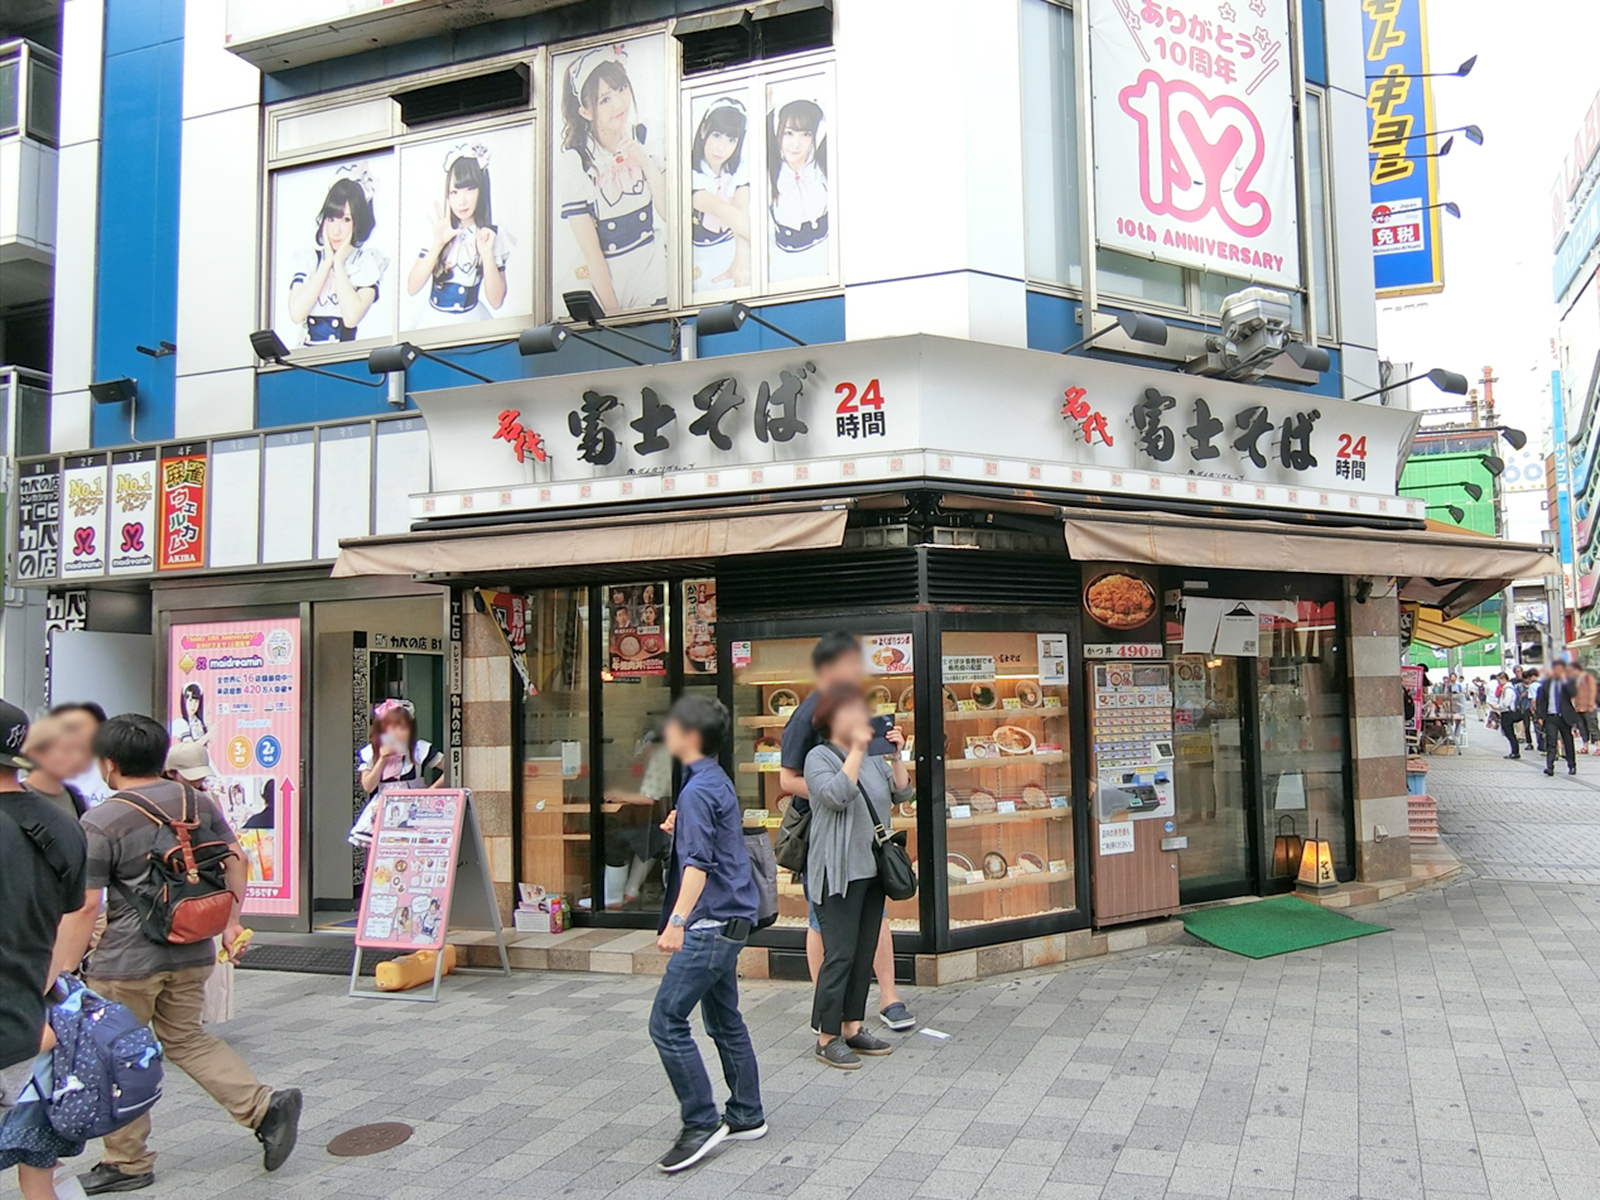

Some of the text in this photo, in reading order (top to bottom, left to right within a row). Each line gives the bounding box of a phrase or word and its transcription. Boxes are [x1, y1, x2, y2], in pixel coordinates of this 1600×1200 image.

[1140, 0, 1255, 59] ありがとう
[1154, 37, 1237, 84] 10周年
[1117, 217, 1284, 272] 10th ANNIVERSARY
[1376, 225, 1415, 246] 免税
[834, 379, 885, 414] 24
[568, 361, 817, 466] 富士そば
[1060, 386, 1113, 447] 名代
[836, 411, 886, 439] 時間
[1132, 388, 1321, 471] 富士そば
[493, 409, 546, 464] 名代
[1337, 433, 1367, 460] 24
[81, 456, 94, 466] 2F
[129, 452, 142, 462] 3F
[36, 464, 45, 474] B1
[165, 460, 206, 488] 麻雀
[1335, 460, 1366, 481] 時間
[69, 477, 104, 498] No.1
[117, 472, 152, 494] No.1
[21, 503, 59, 521] TCG
[169, 489, 199, 554] ウェルカム
[65, 559, 103, 571] maidreamin
[112, 555, 152, 568] maidreamin
[167, 554, 196, 564] AKIBA
[452, 602, 461, 639] TCG
[390, 636, 442, 650] カベの店 B1
[1086, 645, 1161, 657] かつ丼 490円
[209, 654, 264, 669] maidreamin
[451, 695, 461, 745] カベの店
[262, 741, 275, 756] 2F
[453, 751, 460, 777] B1
[1320, 860, 1331, 880] そば
